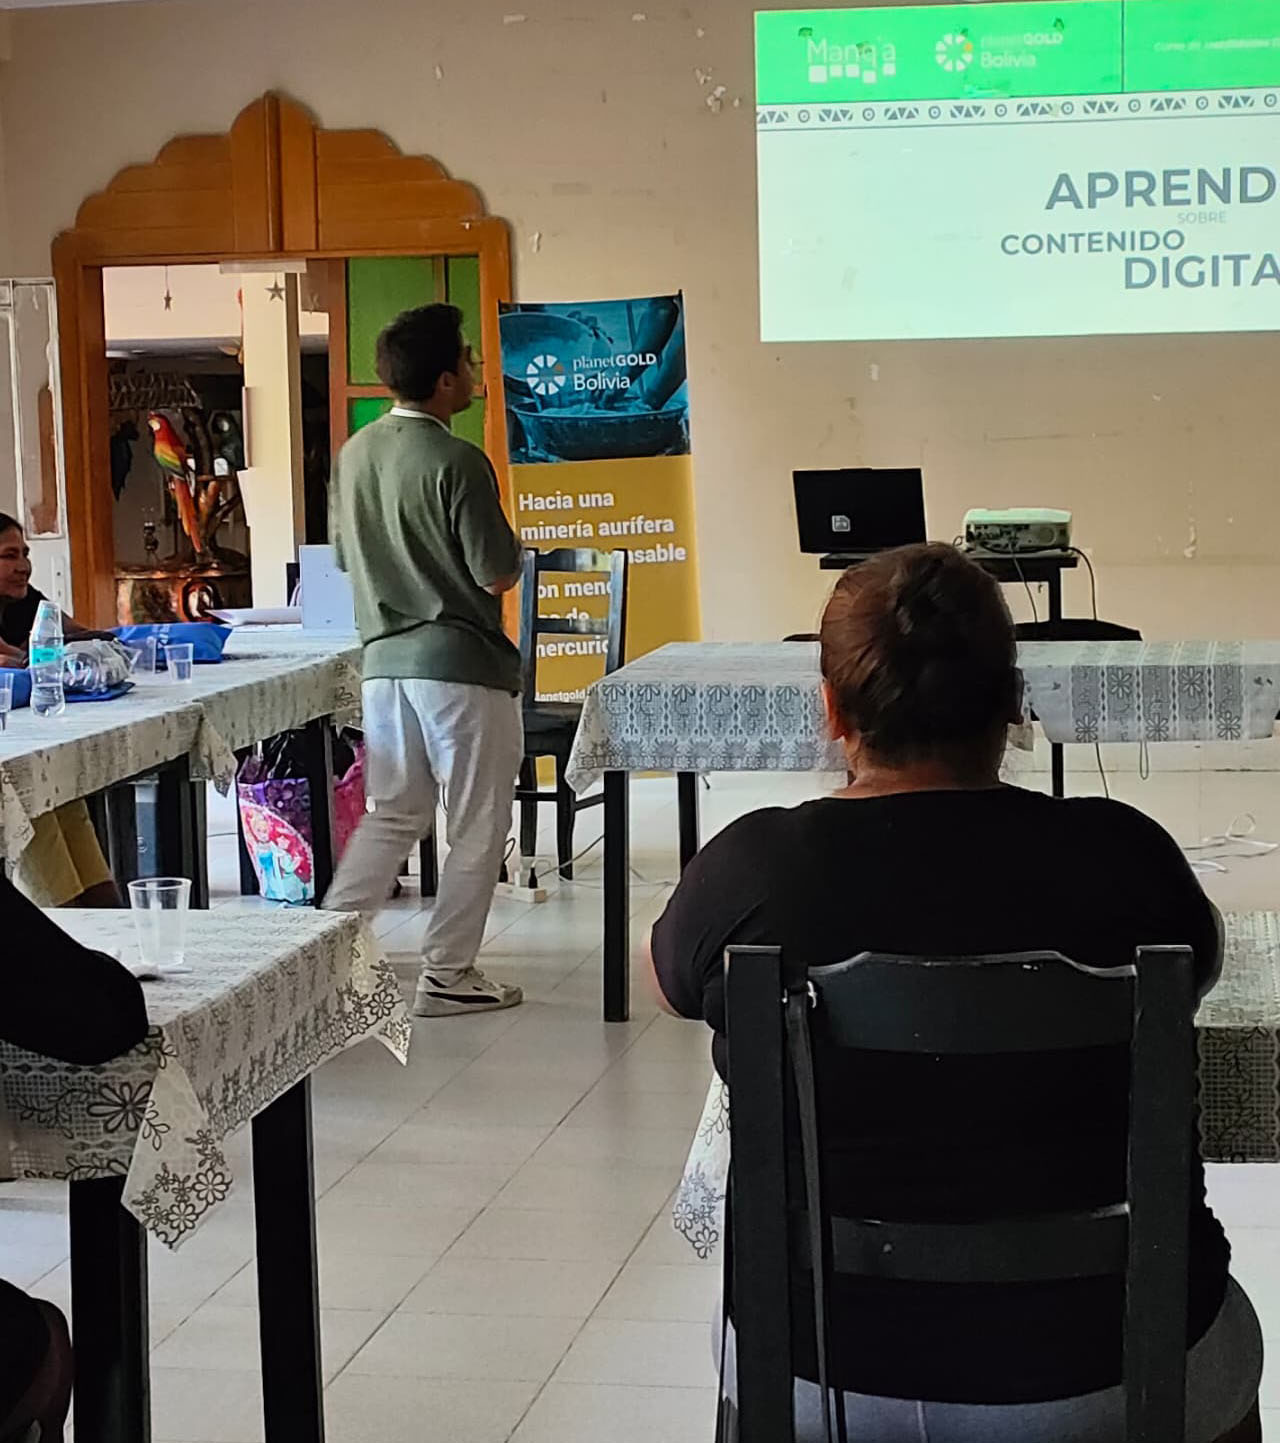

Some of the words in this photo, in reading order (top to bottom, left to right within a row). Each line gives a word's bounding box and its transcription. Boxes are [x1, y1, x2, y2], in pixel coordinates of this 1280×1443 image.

[980, 51, 1036, 69] Bolivia
[1176, 210, 1227, 225] SOBRE
[1000, 229, 1185, 256] CONTENIDO
[572, 353, 657, 371] planetGOLD
[573, 371, 631, 391] Bolivia
[518, 490, 574, 512] Hacia
[578, 492, 614, 508] una
[520, 519, 593, 541] minería
[598, 515, 675, 537] aurífera
[537, 584, 559, 598] on
